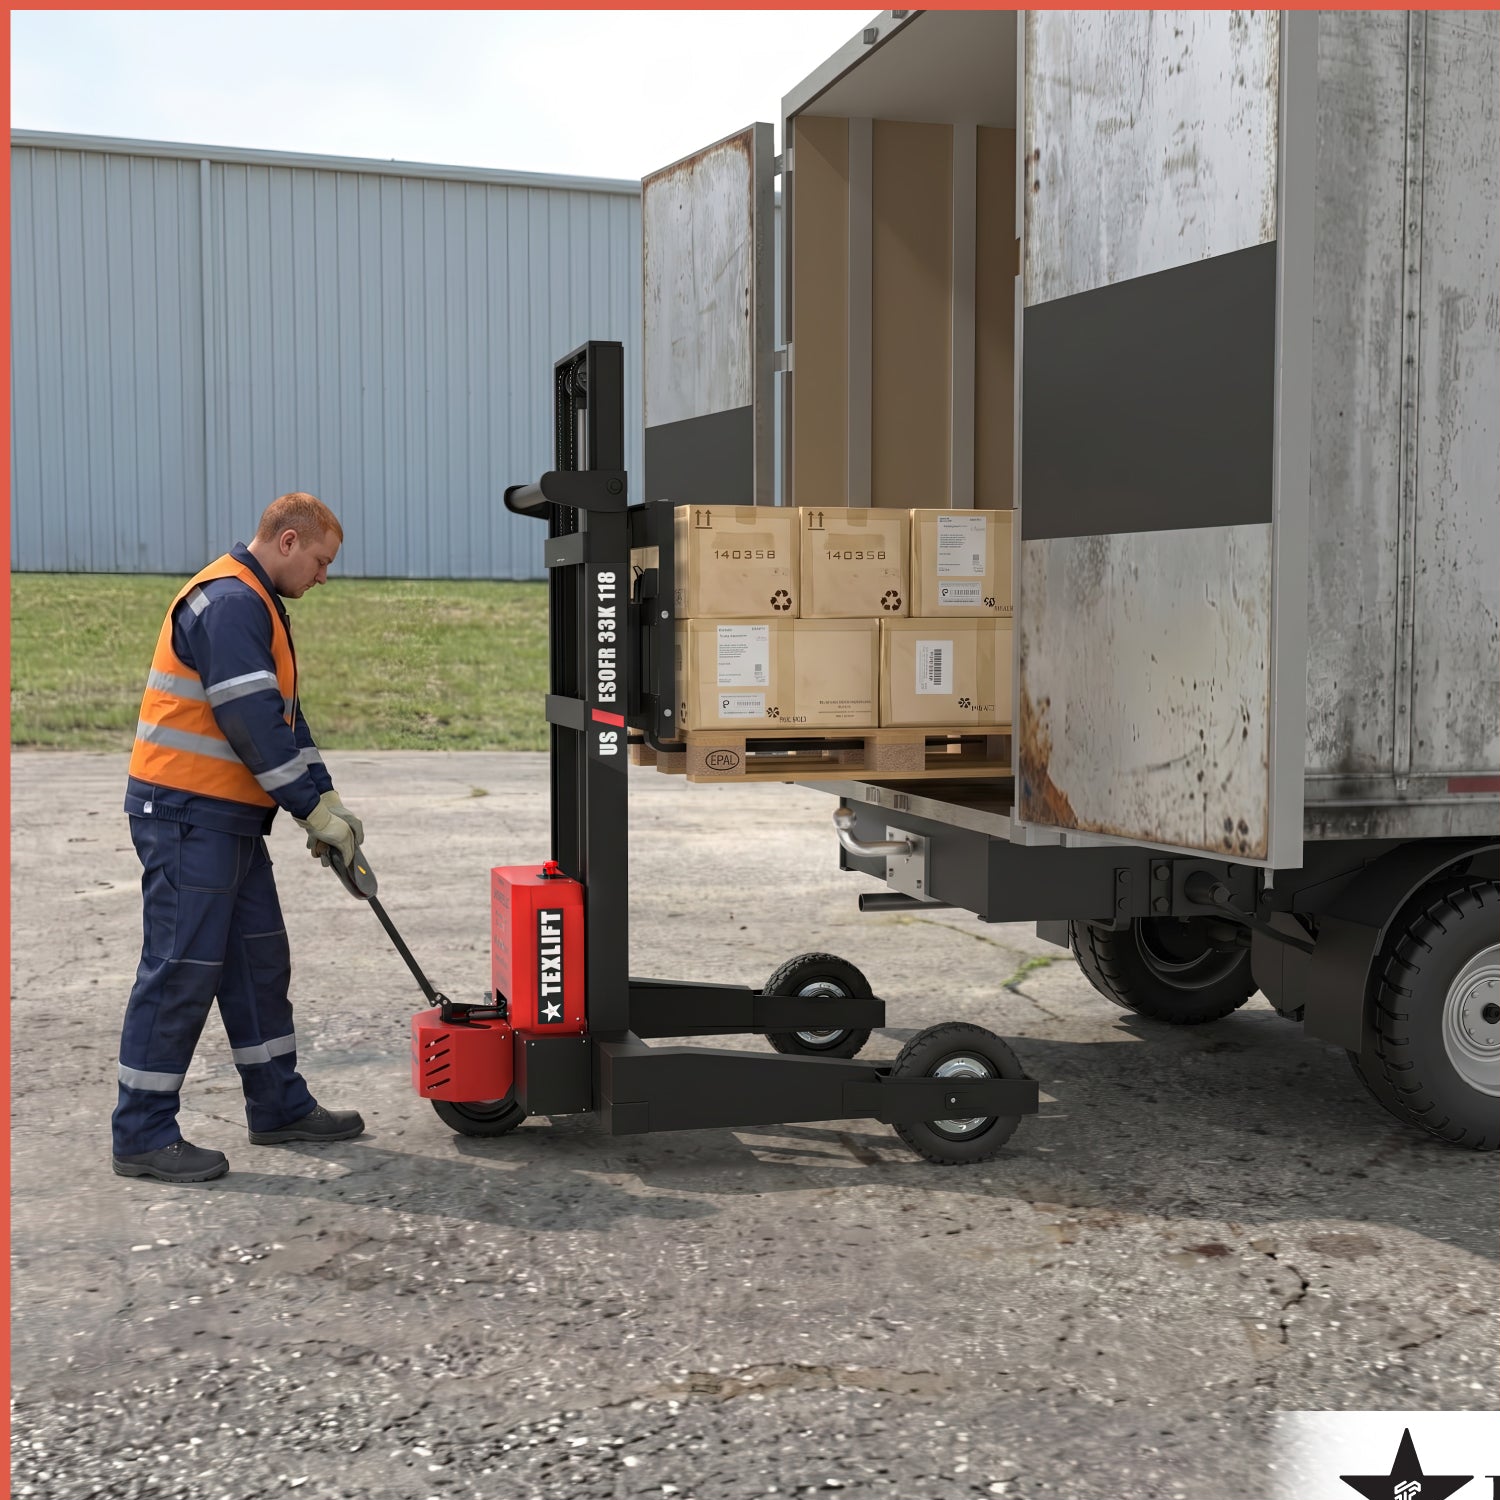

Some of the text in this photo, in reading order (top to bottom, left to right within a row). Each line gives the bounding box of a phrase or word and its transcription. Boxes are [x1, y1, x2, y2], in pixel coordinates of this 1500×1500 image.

[714, 549, 776, 560] 140358
[826, 550, 886, 561] 140358
[598, 571, 617, 756] US ESOFR 33K 118
[710, 753, 736, 767] EPAL
[541, 911, 561, 996] TEXLIFT
